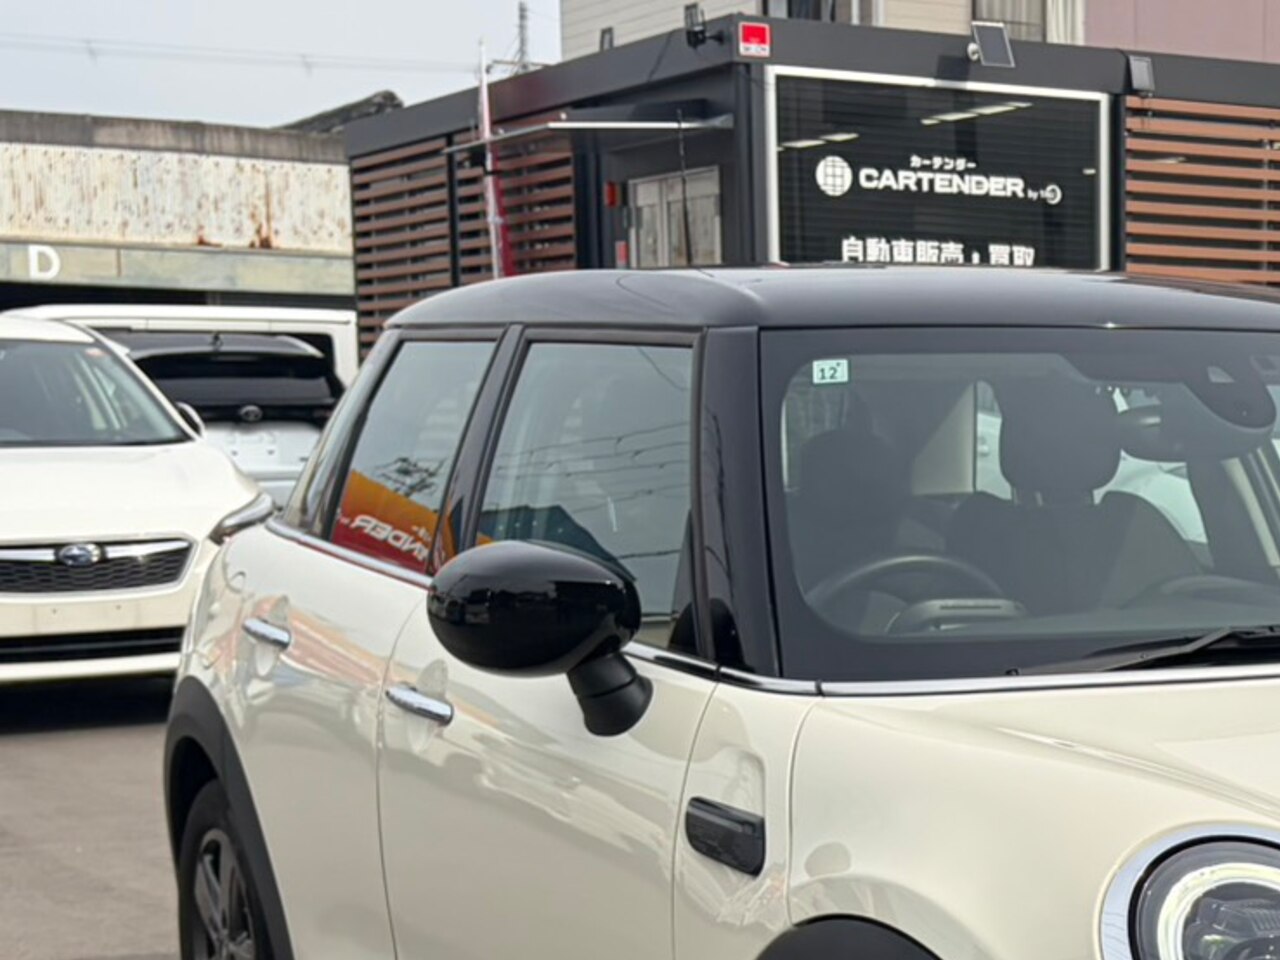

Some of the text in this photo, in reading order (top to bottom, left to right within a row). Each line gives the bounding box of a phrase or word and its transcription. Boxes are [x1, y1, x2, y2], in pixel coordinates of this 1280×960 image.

[910, 154, 977, 171] カーテンダー
[859, 168, 1024, 198] CARTENDER
[29, 245, 60, 279] D
